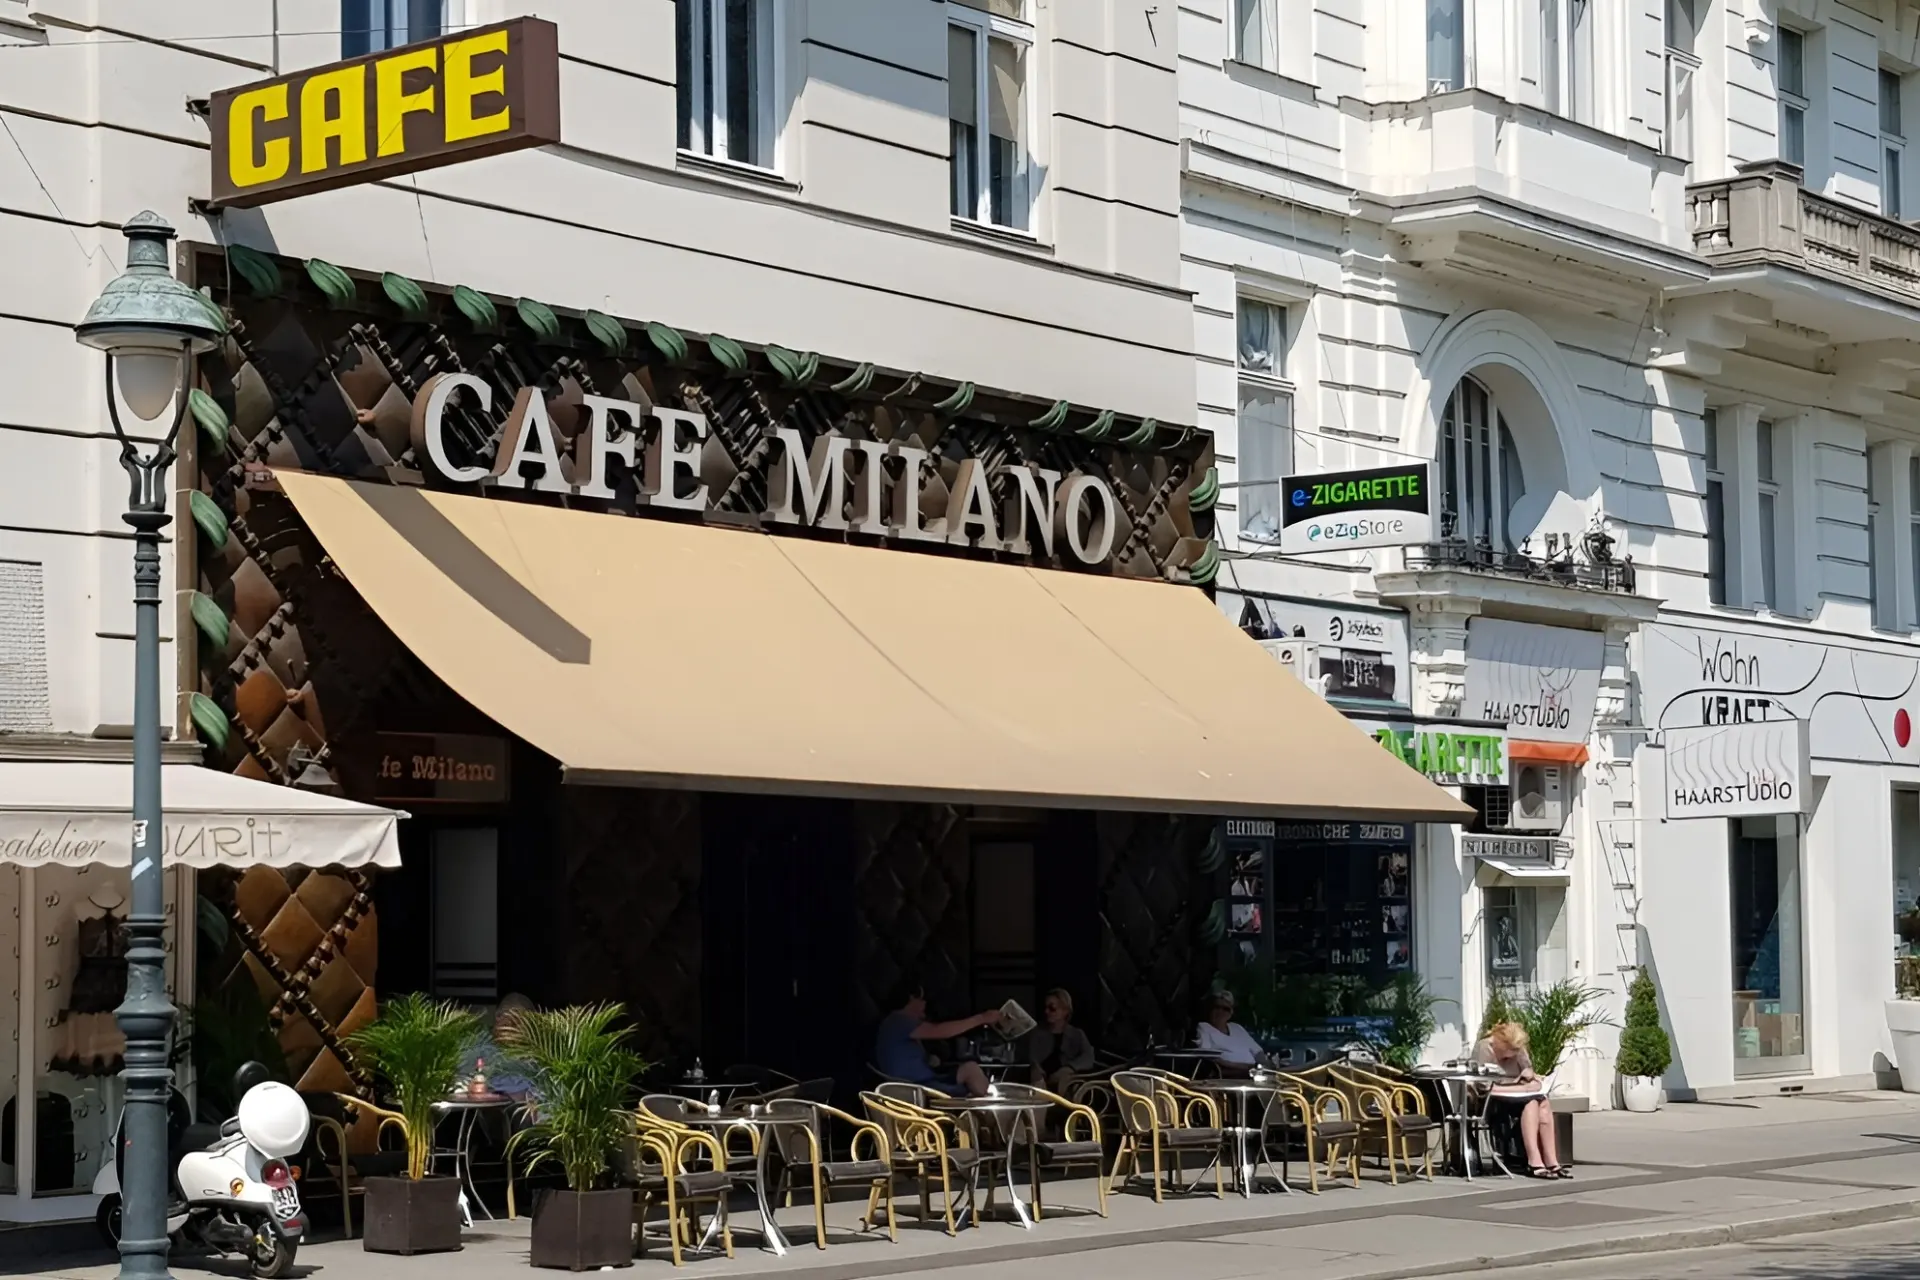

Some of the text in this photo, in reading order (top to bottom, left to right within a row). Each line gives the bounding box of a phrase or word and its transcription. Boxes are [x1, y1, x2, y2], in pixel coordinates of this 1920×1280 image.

[228, 30, 510, 188] CAFE
[418, 371, 1116, 564] CAFE MILANO
[1292, 475, 1419, 506] e-ZIGARETTE
[1483, 689, 1569, 729] HAARSTUDIO
[411, 755, 496, 781] Milano
[1675, 772, 1792, 805] HAARSTUDIO
